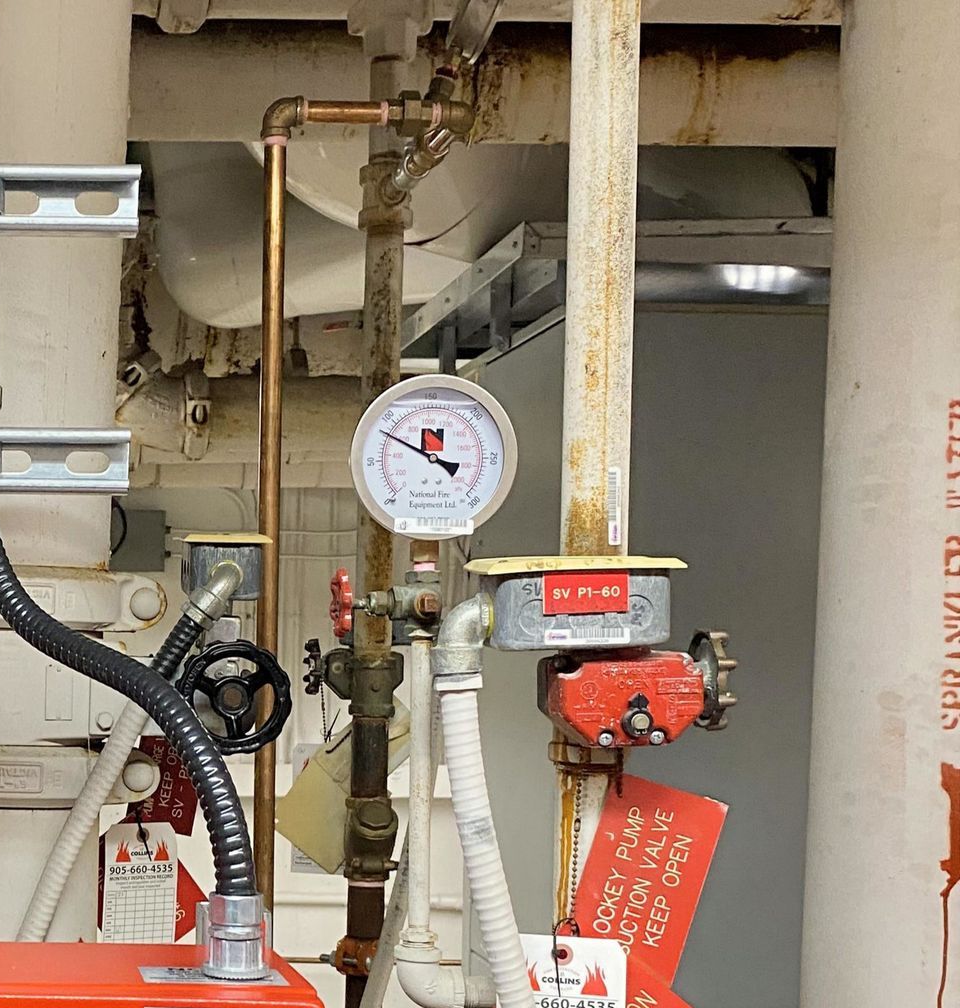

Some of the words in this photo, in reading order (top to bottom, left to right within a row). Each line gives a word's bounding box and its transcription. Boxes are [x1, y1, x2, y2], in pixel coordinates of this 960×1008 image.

[424, 392, 438, 400] 150
[382, 410, 394, 422] 100
[470, 408, 483, 420] 200
[366, 457, 375, 467] 50
[490, 452, 498, 466] 250
[408, 490, 437, 499] National
[437, 490, 450, 499] Fire
[408, 500, 444, 510] Equipment
[444, 500, 456, 509] Ltd.
[468, 496, 481, 510] 300
[552, 587, 571, 599] SV
[577, 586, 621, 598] P1-60
[158, 771, 174, 807] KEEP
[172, 798, 184, 818] SV
[639, 807, 674, 870] VALVE
[109, 864, 173, 875] 905-660-4535
[592, 867, 627, 934] OCKEY
[615, 806, 646, 861] PUMP
[641, 895, 672, 948] KEEP
[662, 834, 694, 888] OPEN
